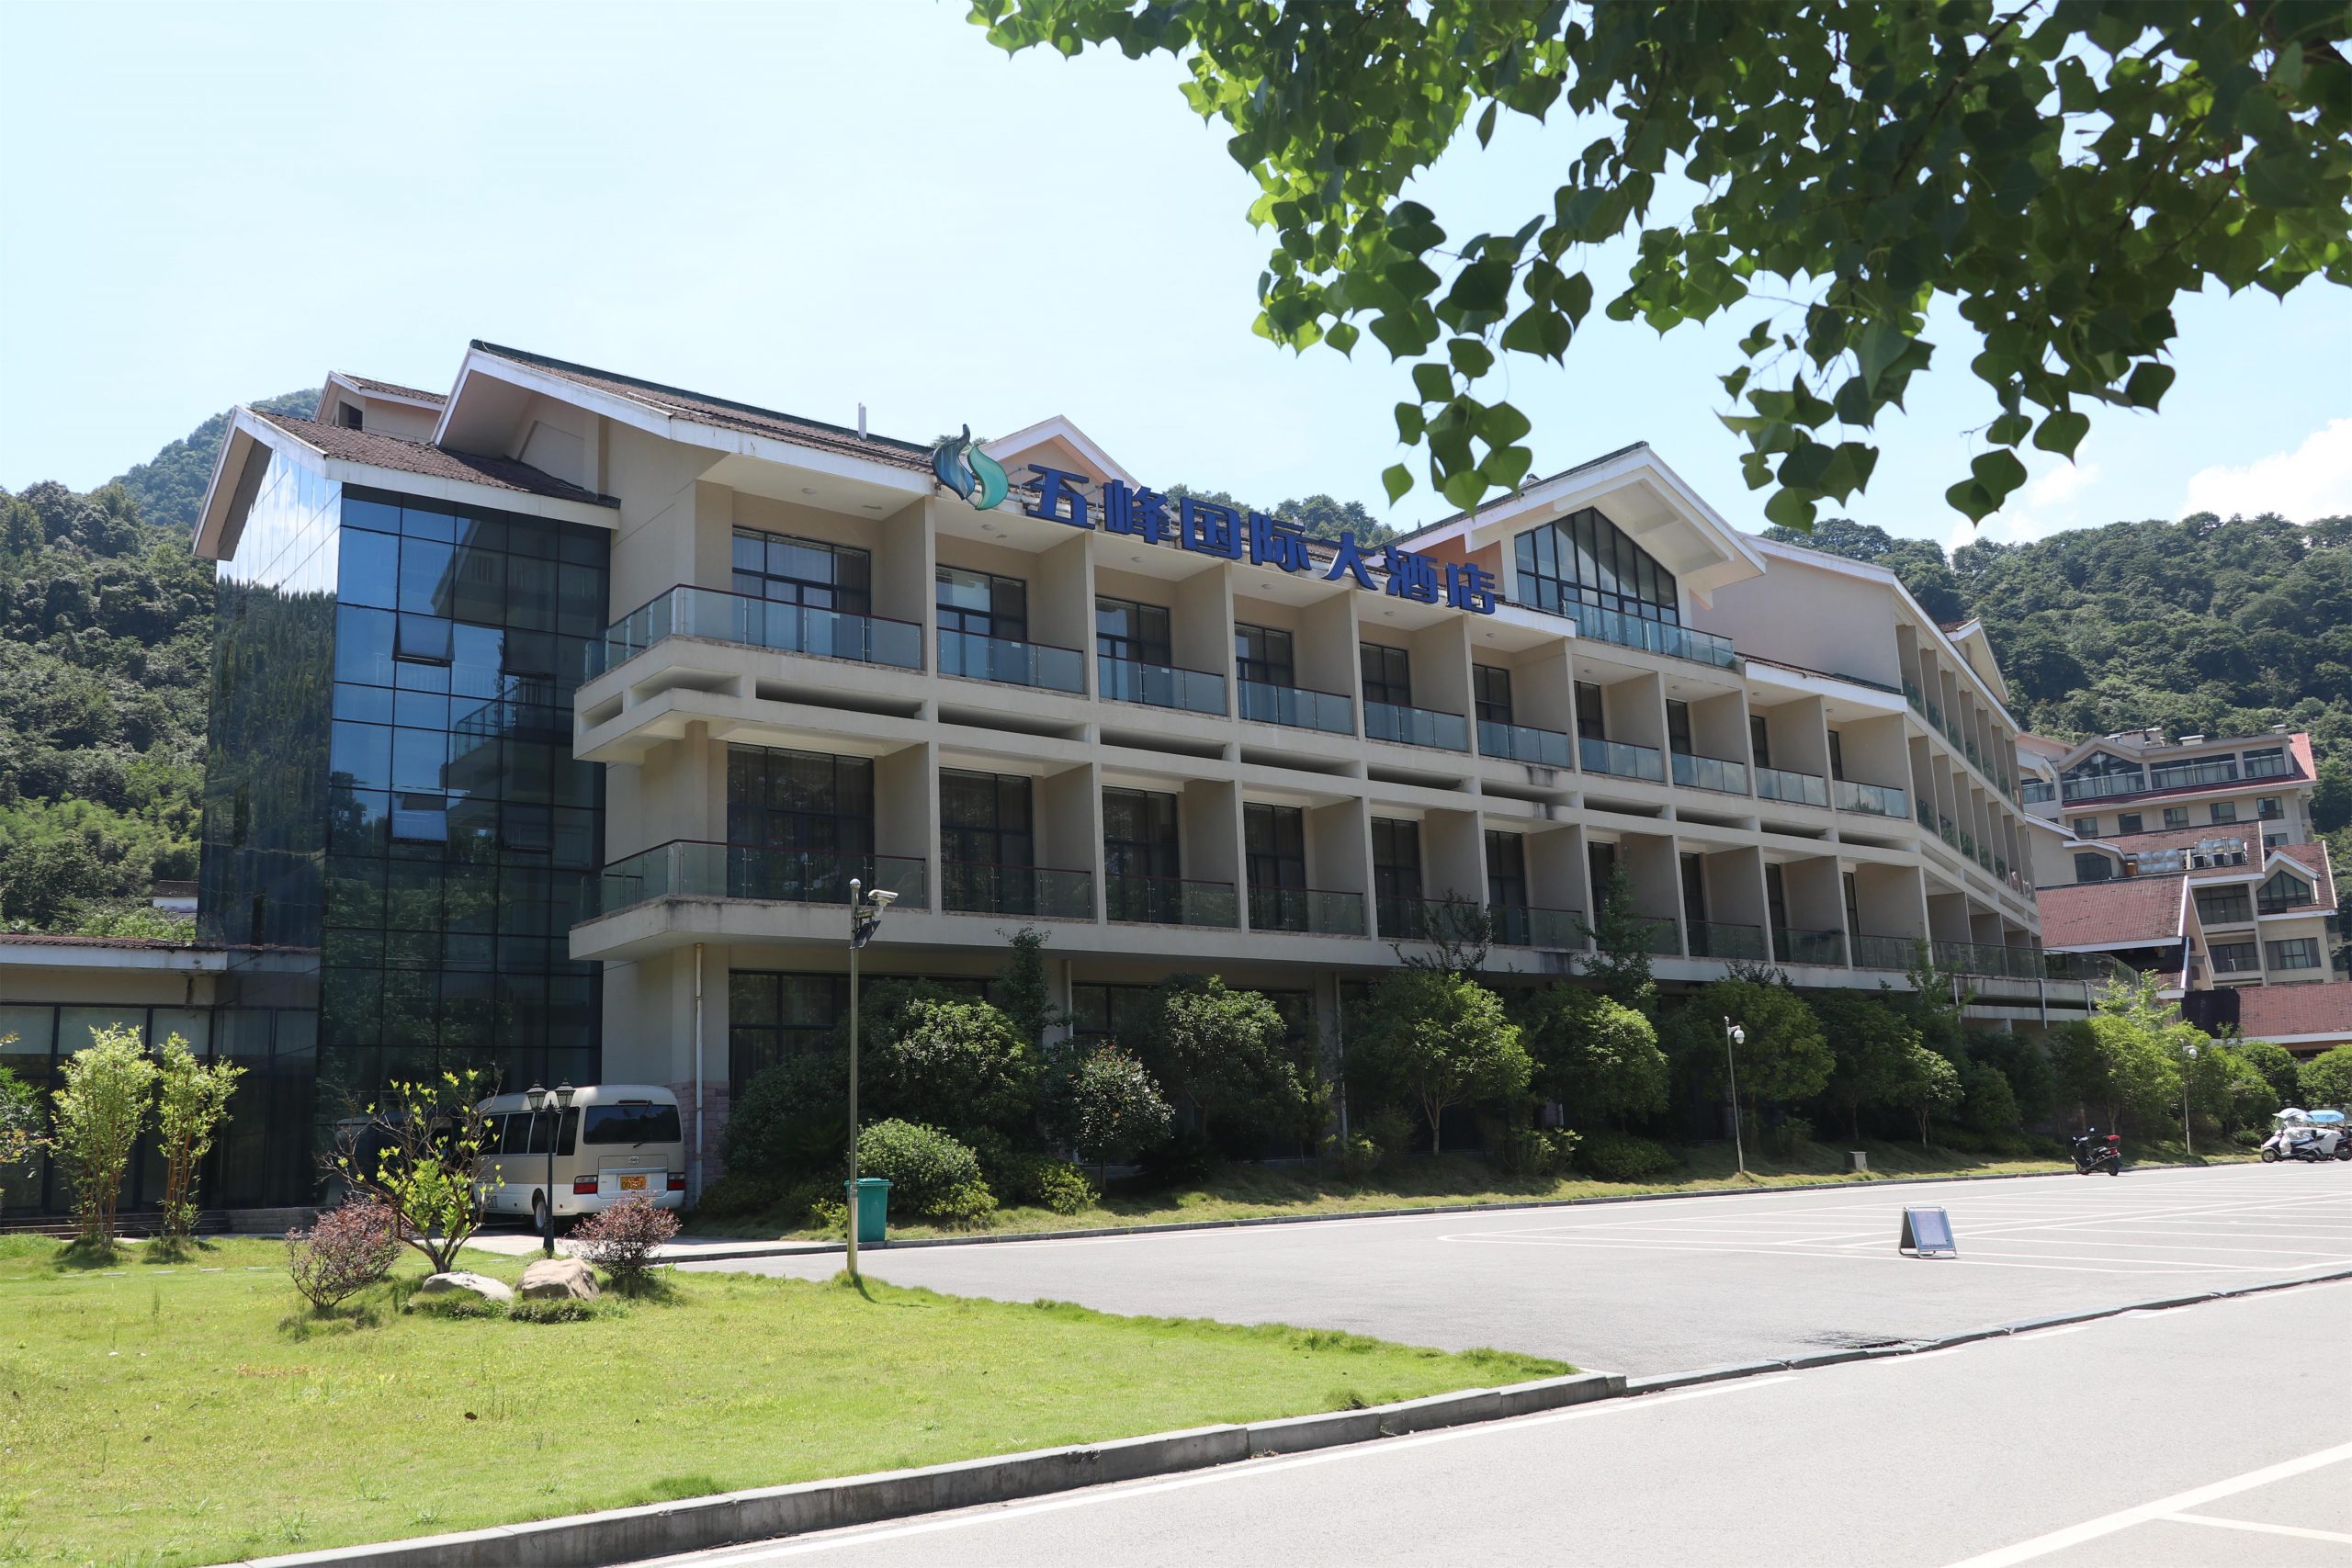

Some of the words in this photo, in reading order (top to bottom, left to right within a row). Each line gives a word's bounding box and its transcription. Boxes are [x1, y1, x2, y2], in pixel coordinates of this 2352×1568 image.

[1026, 463, 1496, 615] 五峰国际大酒店
